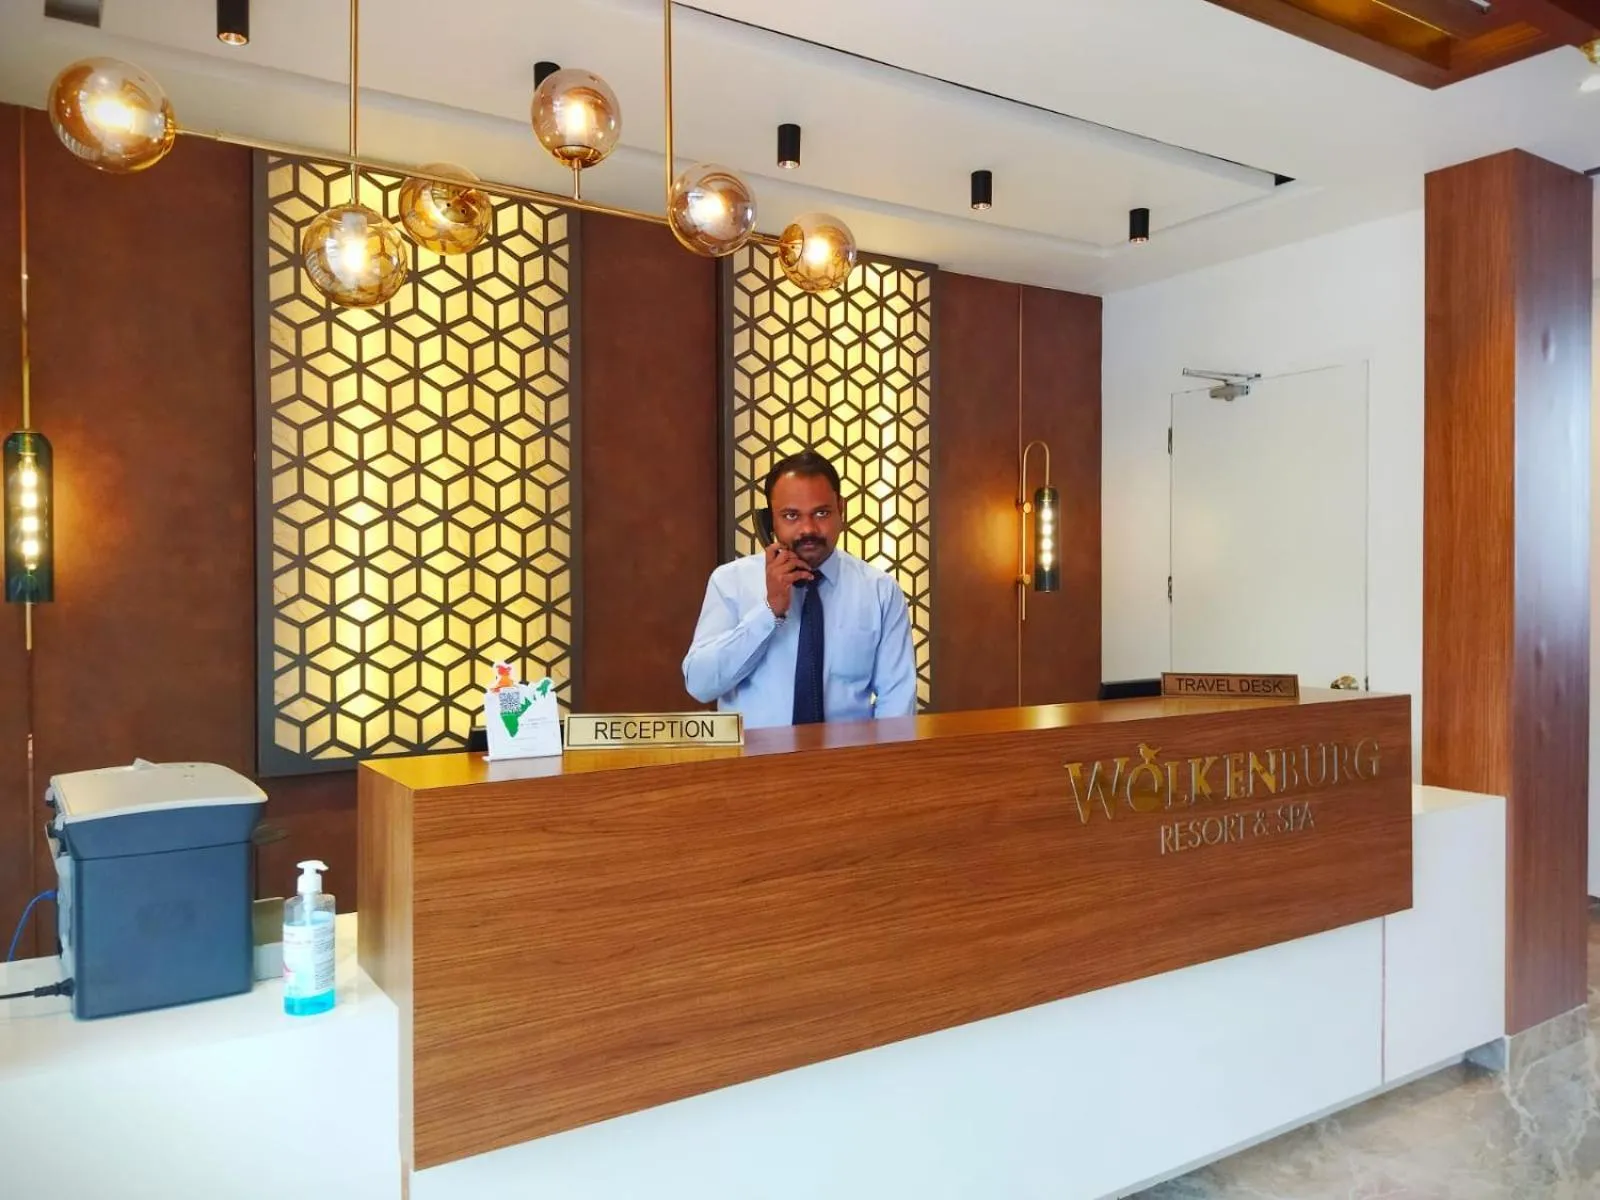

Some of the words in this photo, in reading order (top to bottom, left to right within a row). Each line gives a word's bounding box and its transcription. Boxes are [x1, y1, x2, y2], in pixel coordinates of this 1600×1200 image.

[1176, 676, 1235, 693] TRAVEL
[1239, 677, 1284, 693] DESK
[594, 720, 714, 740] RECEPTION
[1161, 812, 1246, 855] RESORT
[1253, 808, 1269, 836] &
[1276, 801, 1316, 832] SPA
